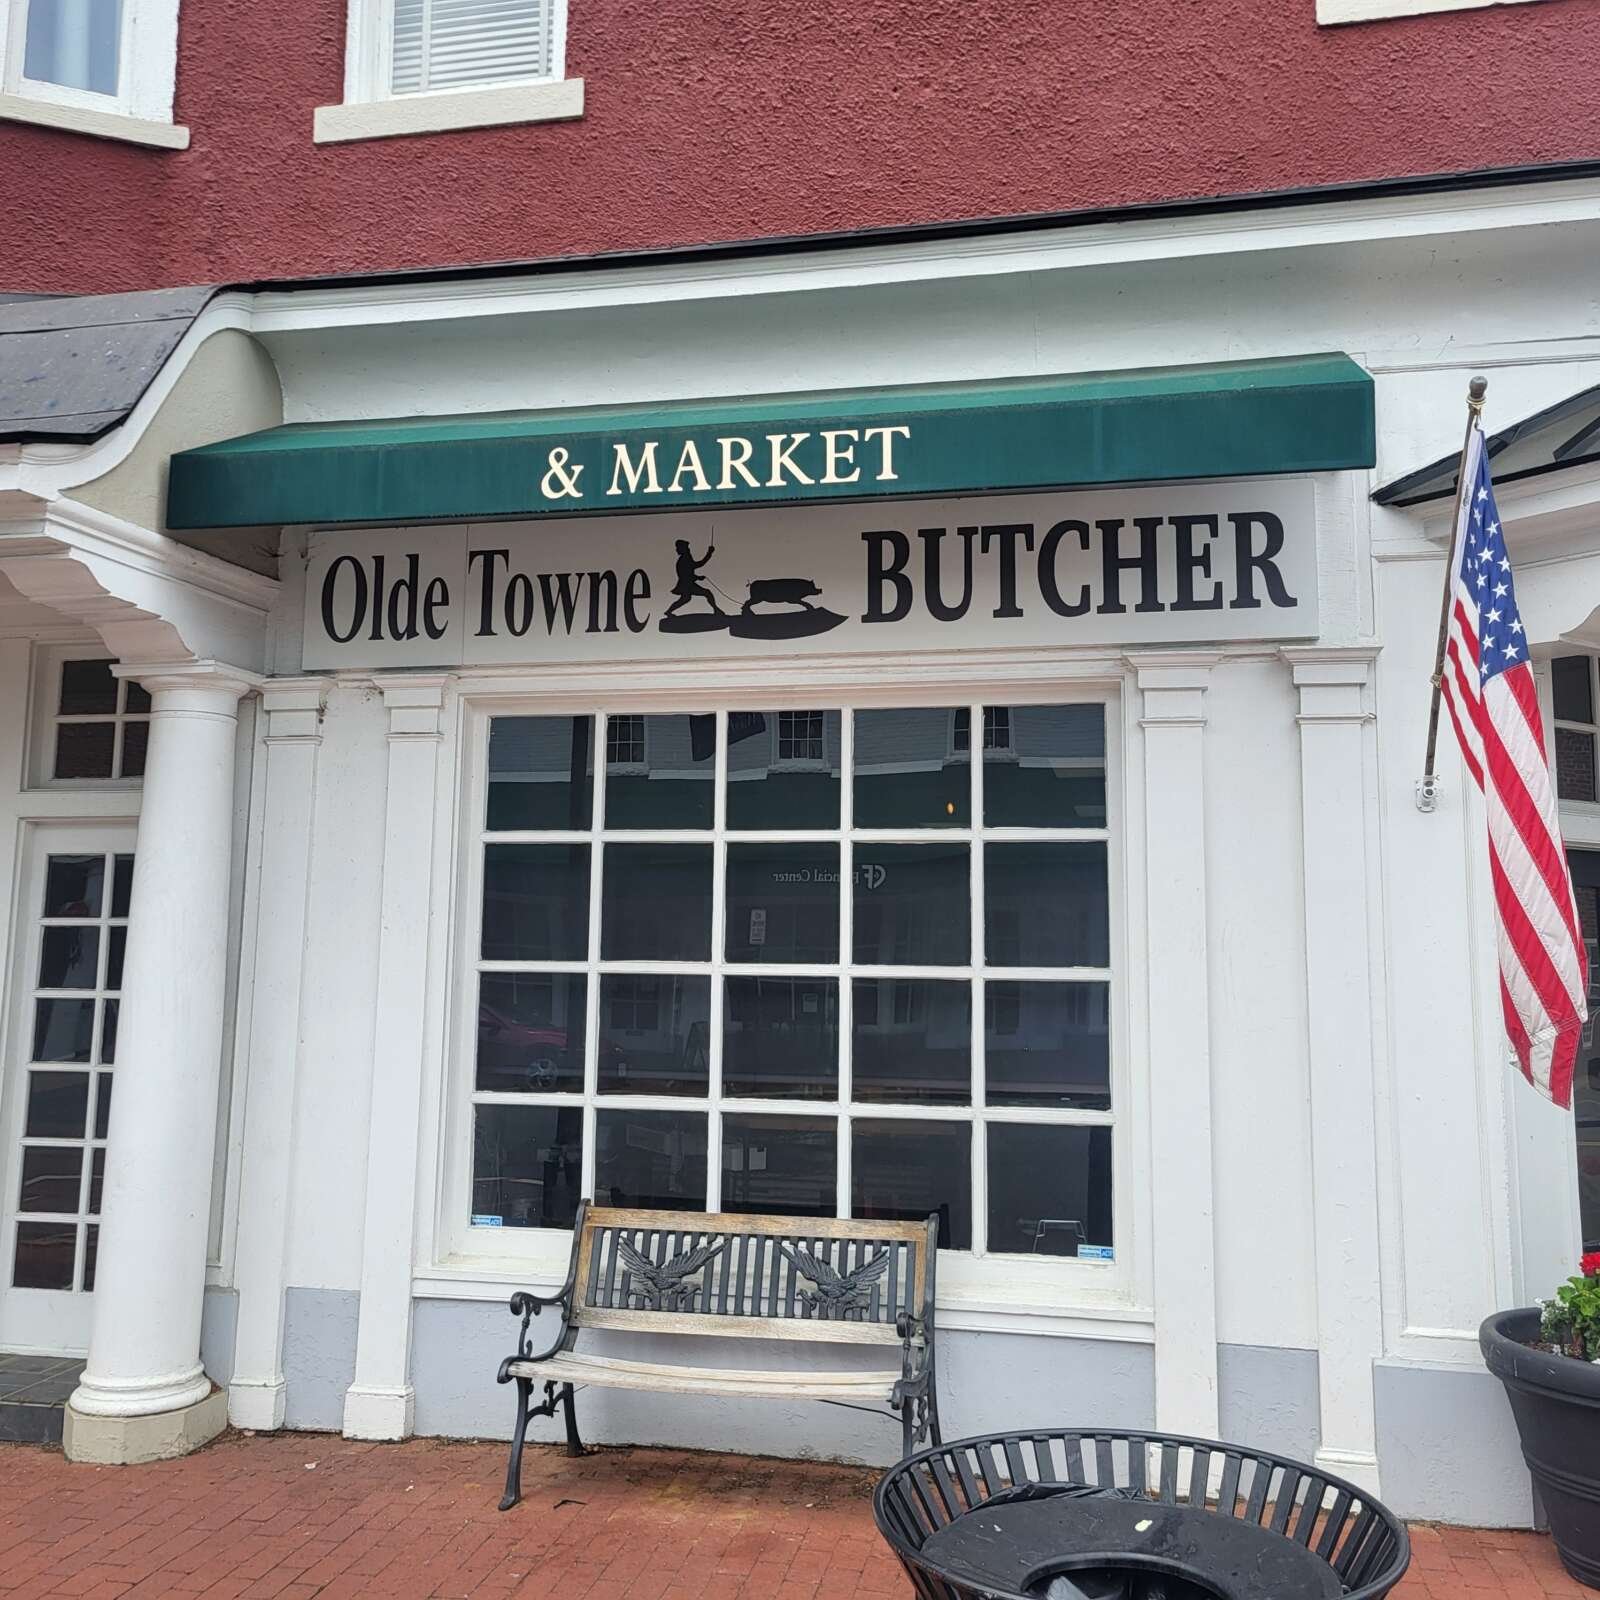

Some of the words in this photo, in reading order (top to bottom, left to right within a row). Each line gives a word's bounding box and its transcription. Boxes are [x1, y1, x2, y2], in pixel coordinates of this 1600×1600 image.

[540, 446, 584, 500] &
[606, 426, 911, 497] MARKET
[321, 553, 450, 644] Olde
[468, 549, 652, 637] Towne
[861, 510, 1298, 624] BUTCHER
